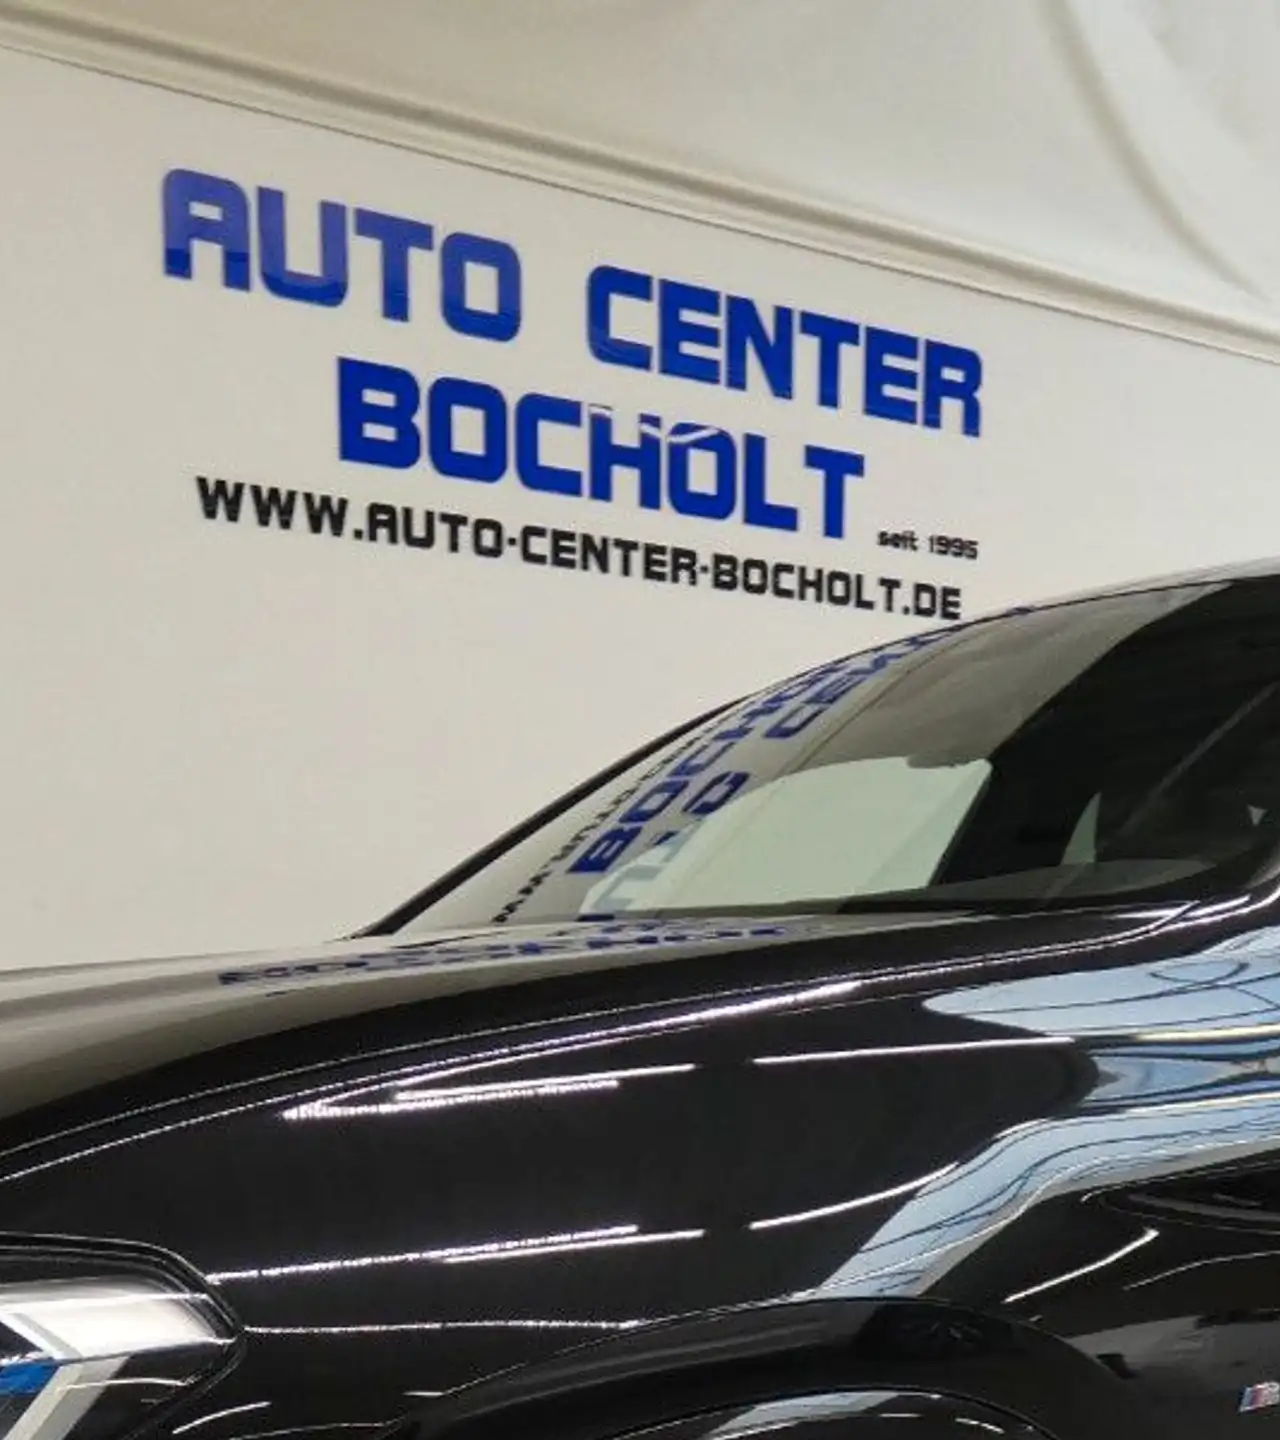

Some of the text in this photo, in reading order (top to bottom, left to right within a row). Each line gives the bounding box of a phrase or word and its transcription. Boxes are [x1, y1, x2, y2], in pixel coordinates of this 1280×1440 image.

[162, 168, 983, 440] AUTO CENTER
[337, 357, 867, 540] BOCHOLT
[196, 475, 962, 621] WWW.AUTO-CENTER-BOCHOLT.DE
[877, 530, 979, 560] seit 1995
